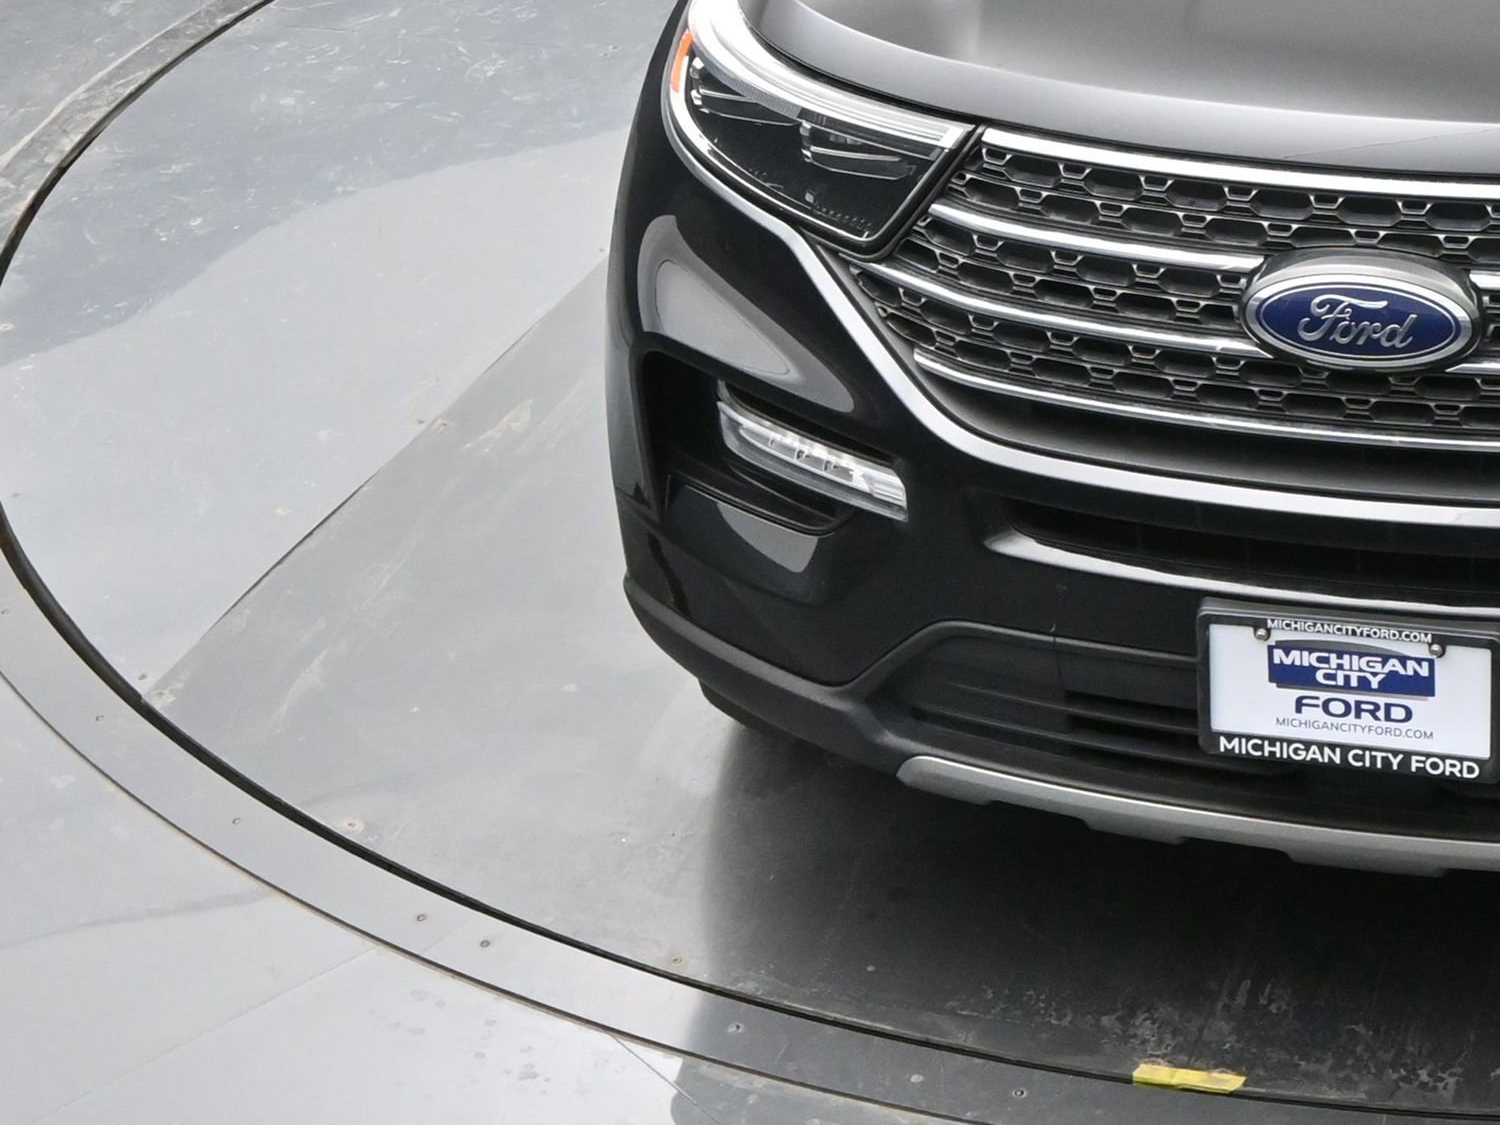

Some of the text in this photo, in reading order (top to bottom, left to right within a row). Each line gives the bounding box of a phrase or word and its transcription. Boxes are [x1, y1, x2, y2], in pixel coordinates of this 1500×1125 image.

[1298, 294, 1418, 348] Ford
[1267, 618, 1432, 644] MICHIGANCITYFORD.COM
[1272, 648, 1430, 677] MICHIGAN
[1315, 669, 1386, 689] CITY
[1295, 695, 1413, 724] FORD
[1275, 717, 1434, 740] MICHIGANCITYFORD.COM
[1219, 736, 1480, 780] MICHIGAN CITY FORD
